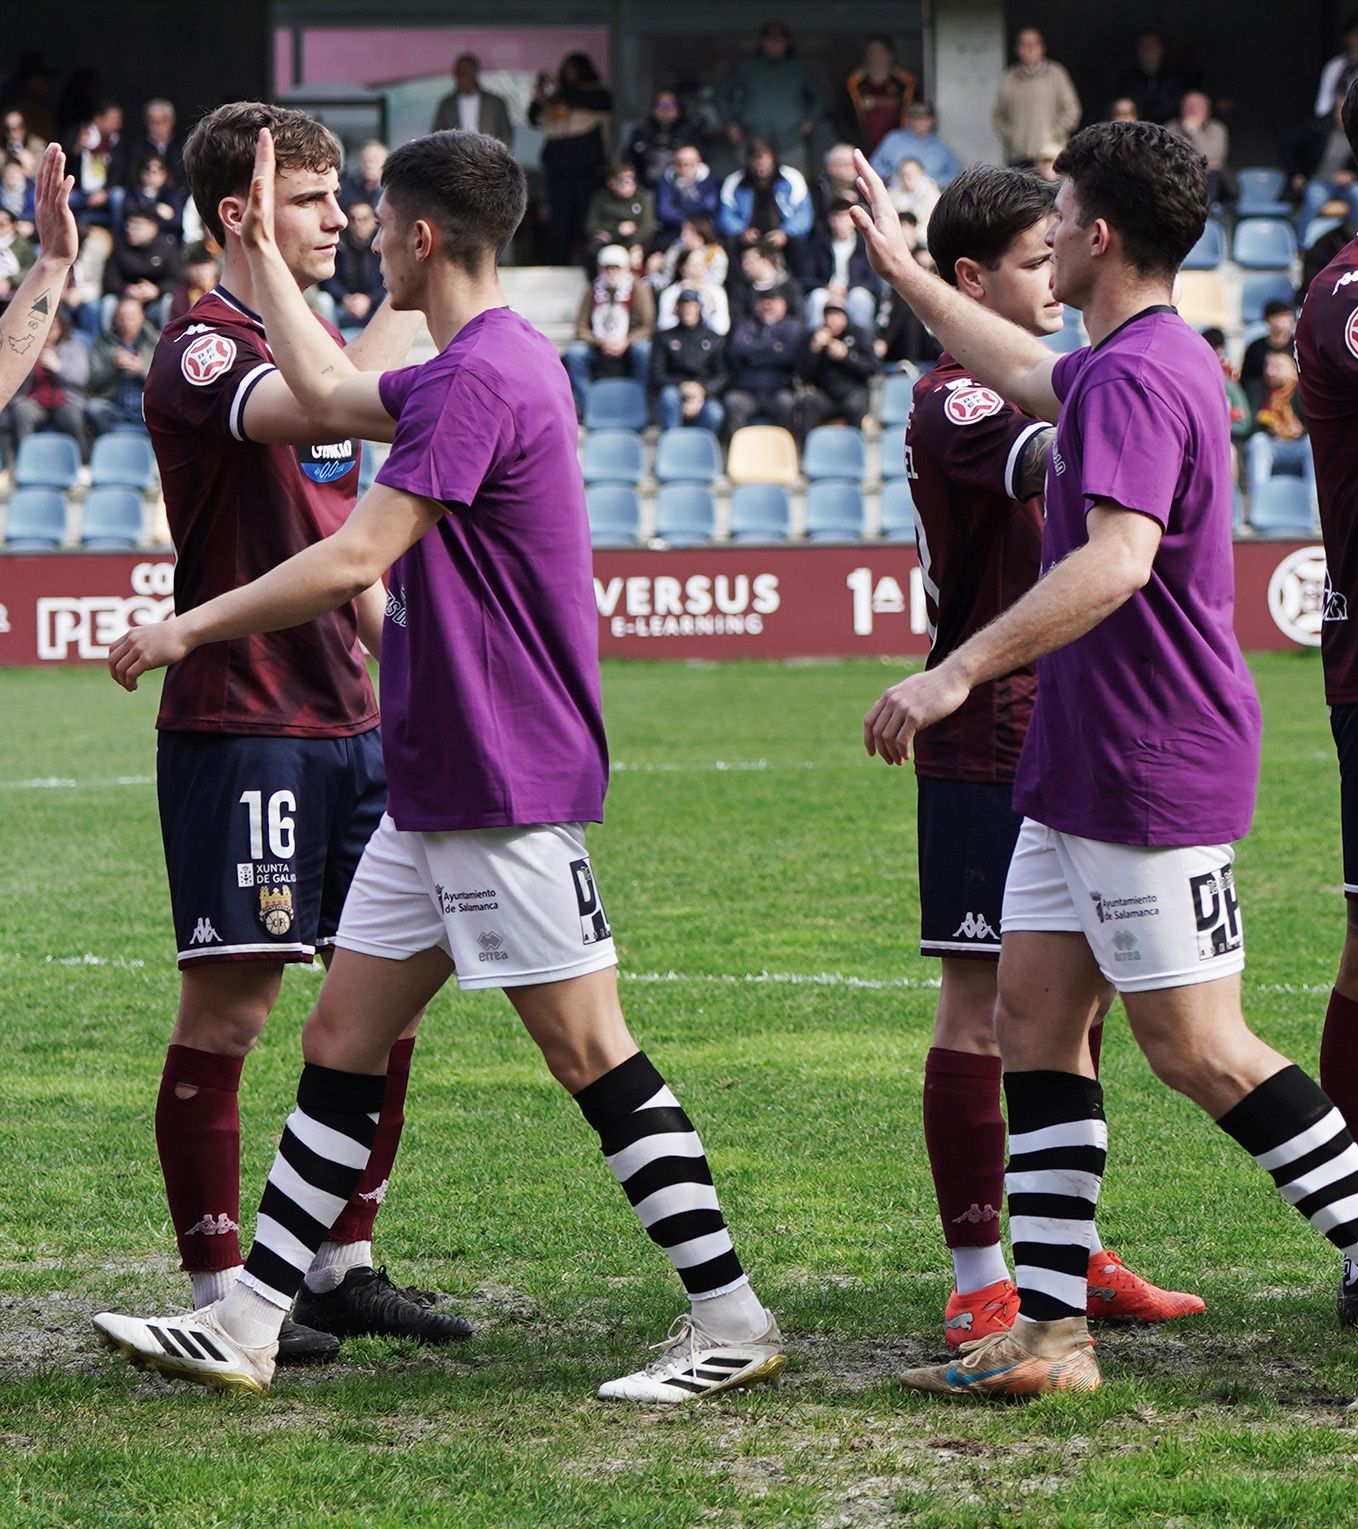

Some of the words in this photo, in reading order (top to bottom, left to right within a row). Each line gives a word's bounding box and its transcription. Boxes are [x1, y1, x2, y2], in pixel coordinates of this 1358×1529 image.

[131, 562, 174, 595] CO
[593, 573, 780, 617] VERSUS
[611, 613, 763, 637] E-LEARNING
[239, 789, 297, 859] 16
[256, 863, 290, 874] XUNTA
[256, 874, 271, 884] DE
[444, 889, 497, 904] Ayuntamiento
[445, 904, 456, 914] de
[458, 900, 499, 913] Salamanca
[1114, 907, 1160, 920] Salamanca
